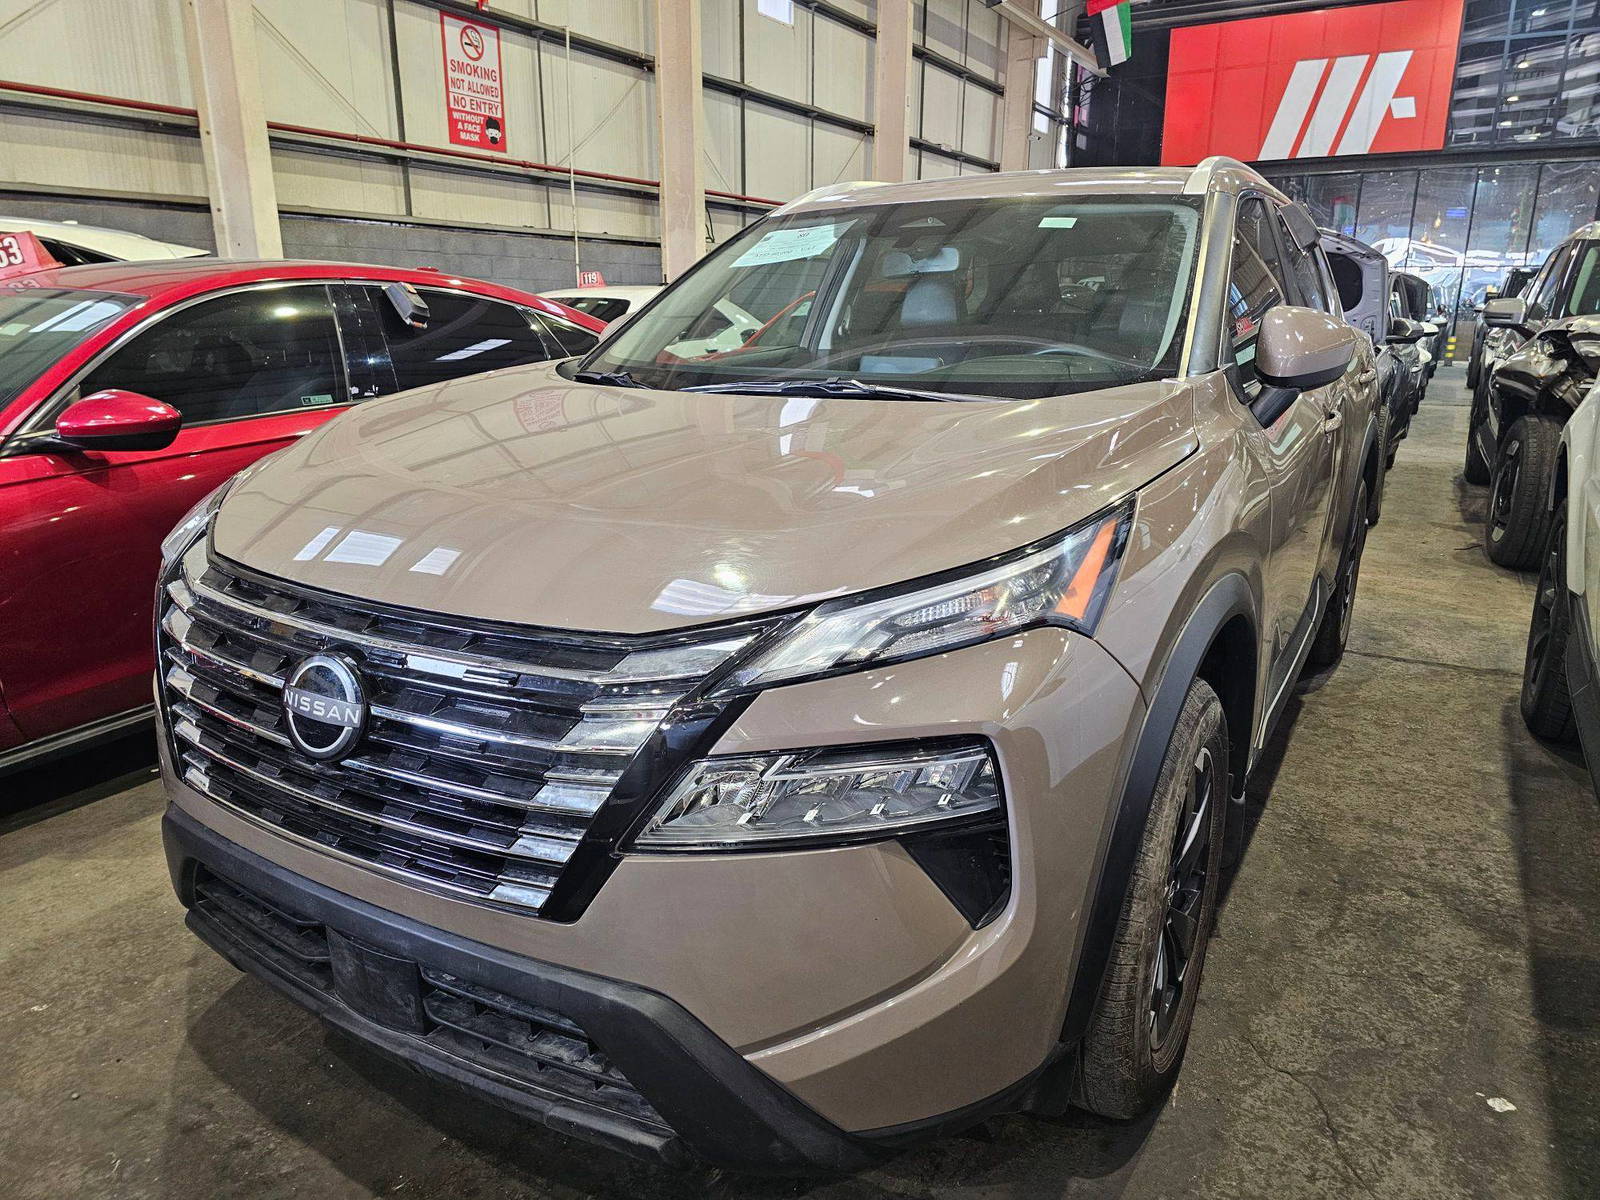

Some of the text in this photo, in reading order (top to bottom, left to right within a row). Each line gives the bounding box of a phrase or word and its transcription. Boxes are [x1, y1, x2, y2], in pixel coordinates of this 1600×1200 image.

[450, 59, 497, 82] SMOKING
[450, 77, 499, 98] NOT ALLOWED
[453, 95, 499, 116] NO ENTRY
[452, 111, 484, 123] WITHOUT
[457, 121, 481, 133] A FACE
[460, 131, 480, 142] MASK
[583, 272, 598, 284] 119
[284, 688, 360, 724] NISSAN
